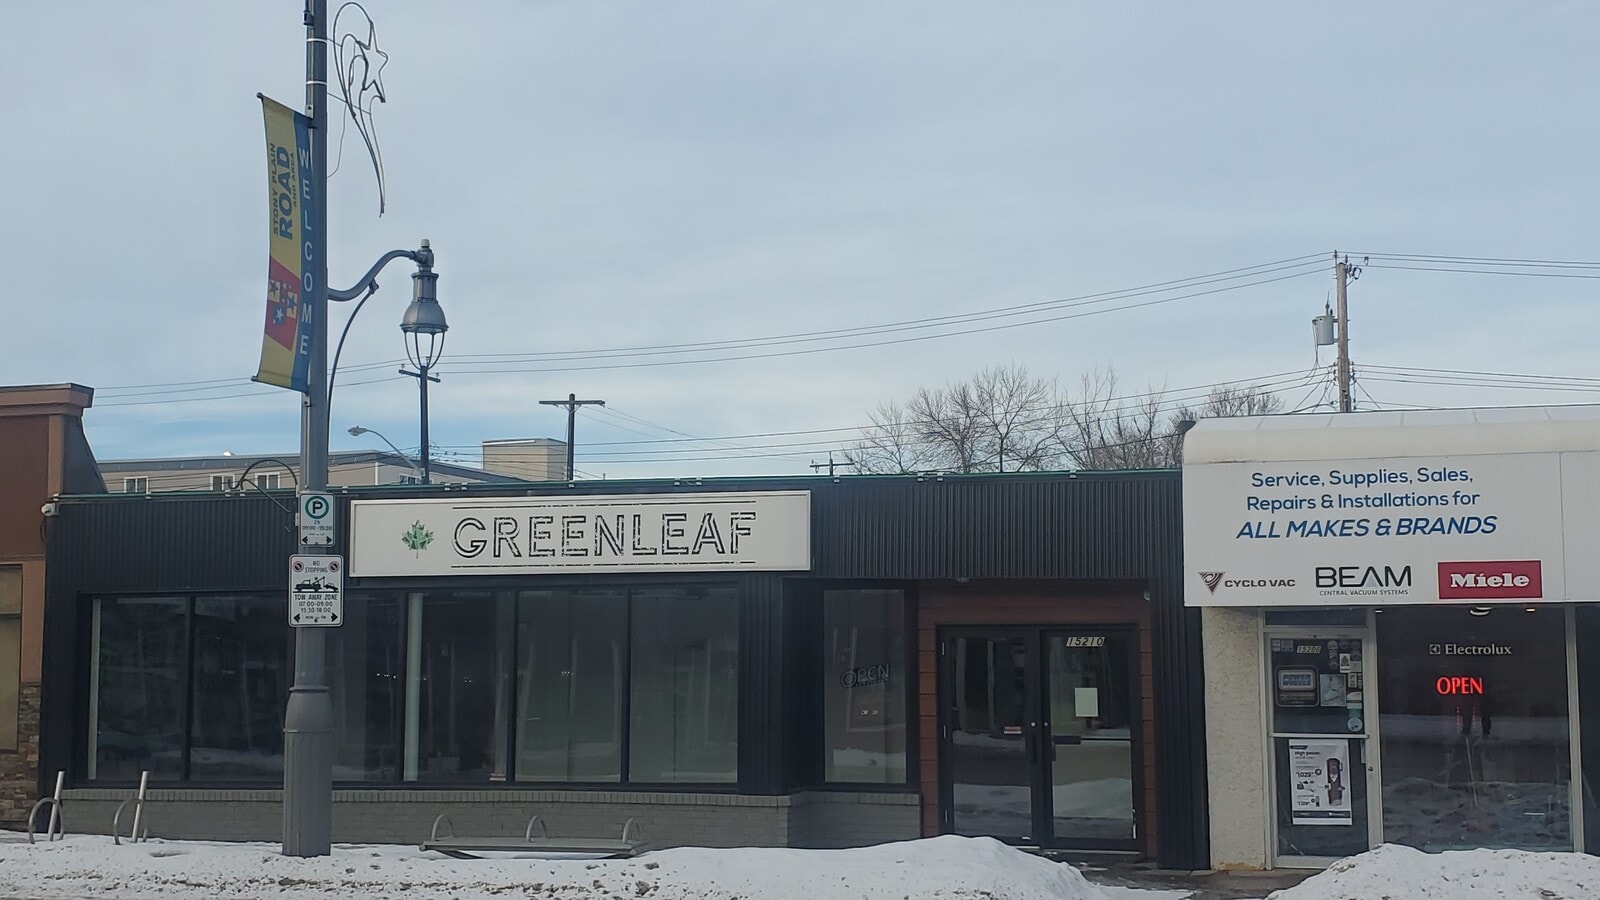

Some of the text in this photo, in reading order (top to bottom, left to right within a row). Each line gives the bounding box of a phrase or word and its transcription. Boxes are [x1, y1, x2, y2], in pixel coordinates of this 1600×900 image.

[277, 146, 293, 240] ROAD
[298, 150, 313, 355] WELCOME
[1251, 466, 1473, 489] Service, Supplies, Sales,
[1246, 490, 1480, 513] Repairs & Installations for
[452, 511, 756, 559] GREENLEAF
[1235, 515, 1498, 539] ALL MAKES & BRANDS
[1224, 577, 1296, 588] CYCLO VAC
[1315, 565, 1412, 588] BEAM
[1449, 572, 1530, 588] Miele
[1067, 637, 1104, 647] 15210
[1445, 643, 1512, 656] Electrolux
[841, 664, 889, 688] OPEN
[1436, 676, 1484, 695] OPEN
